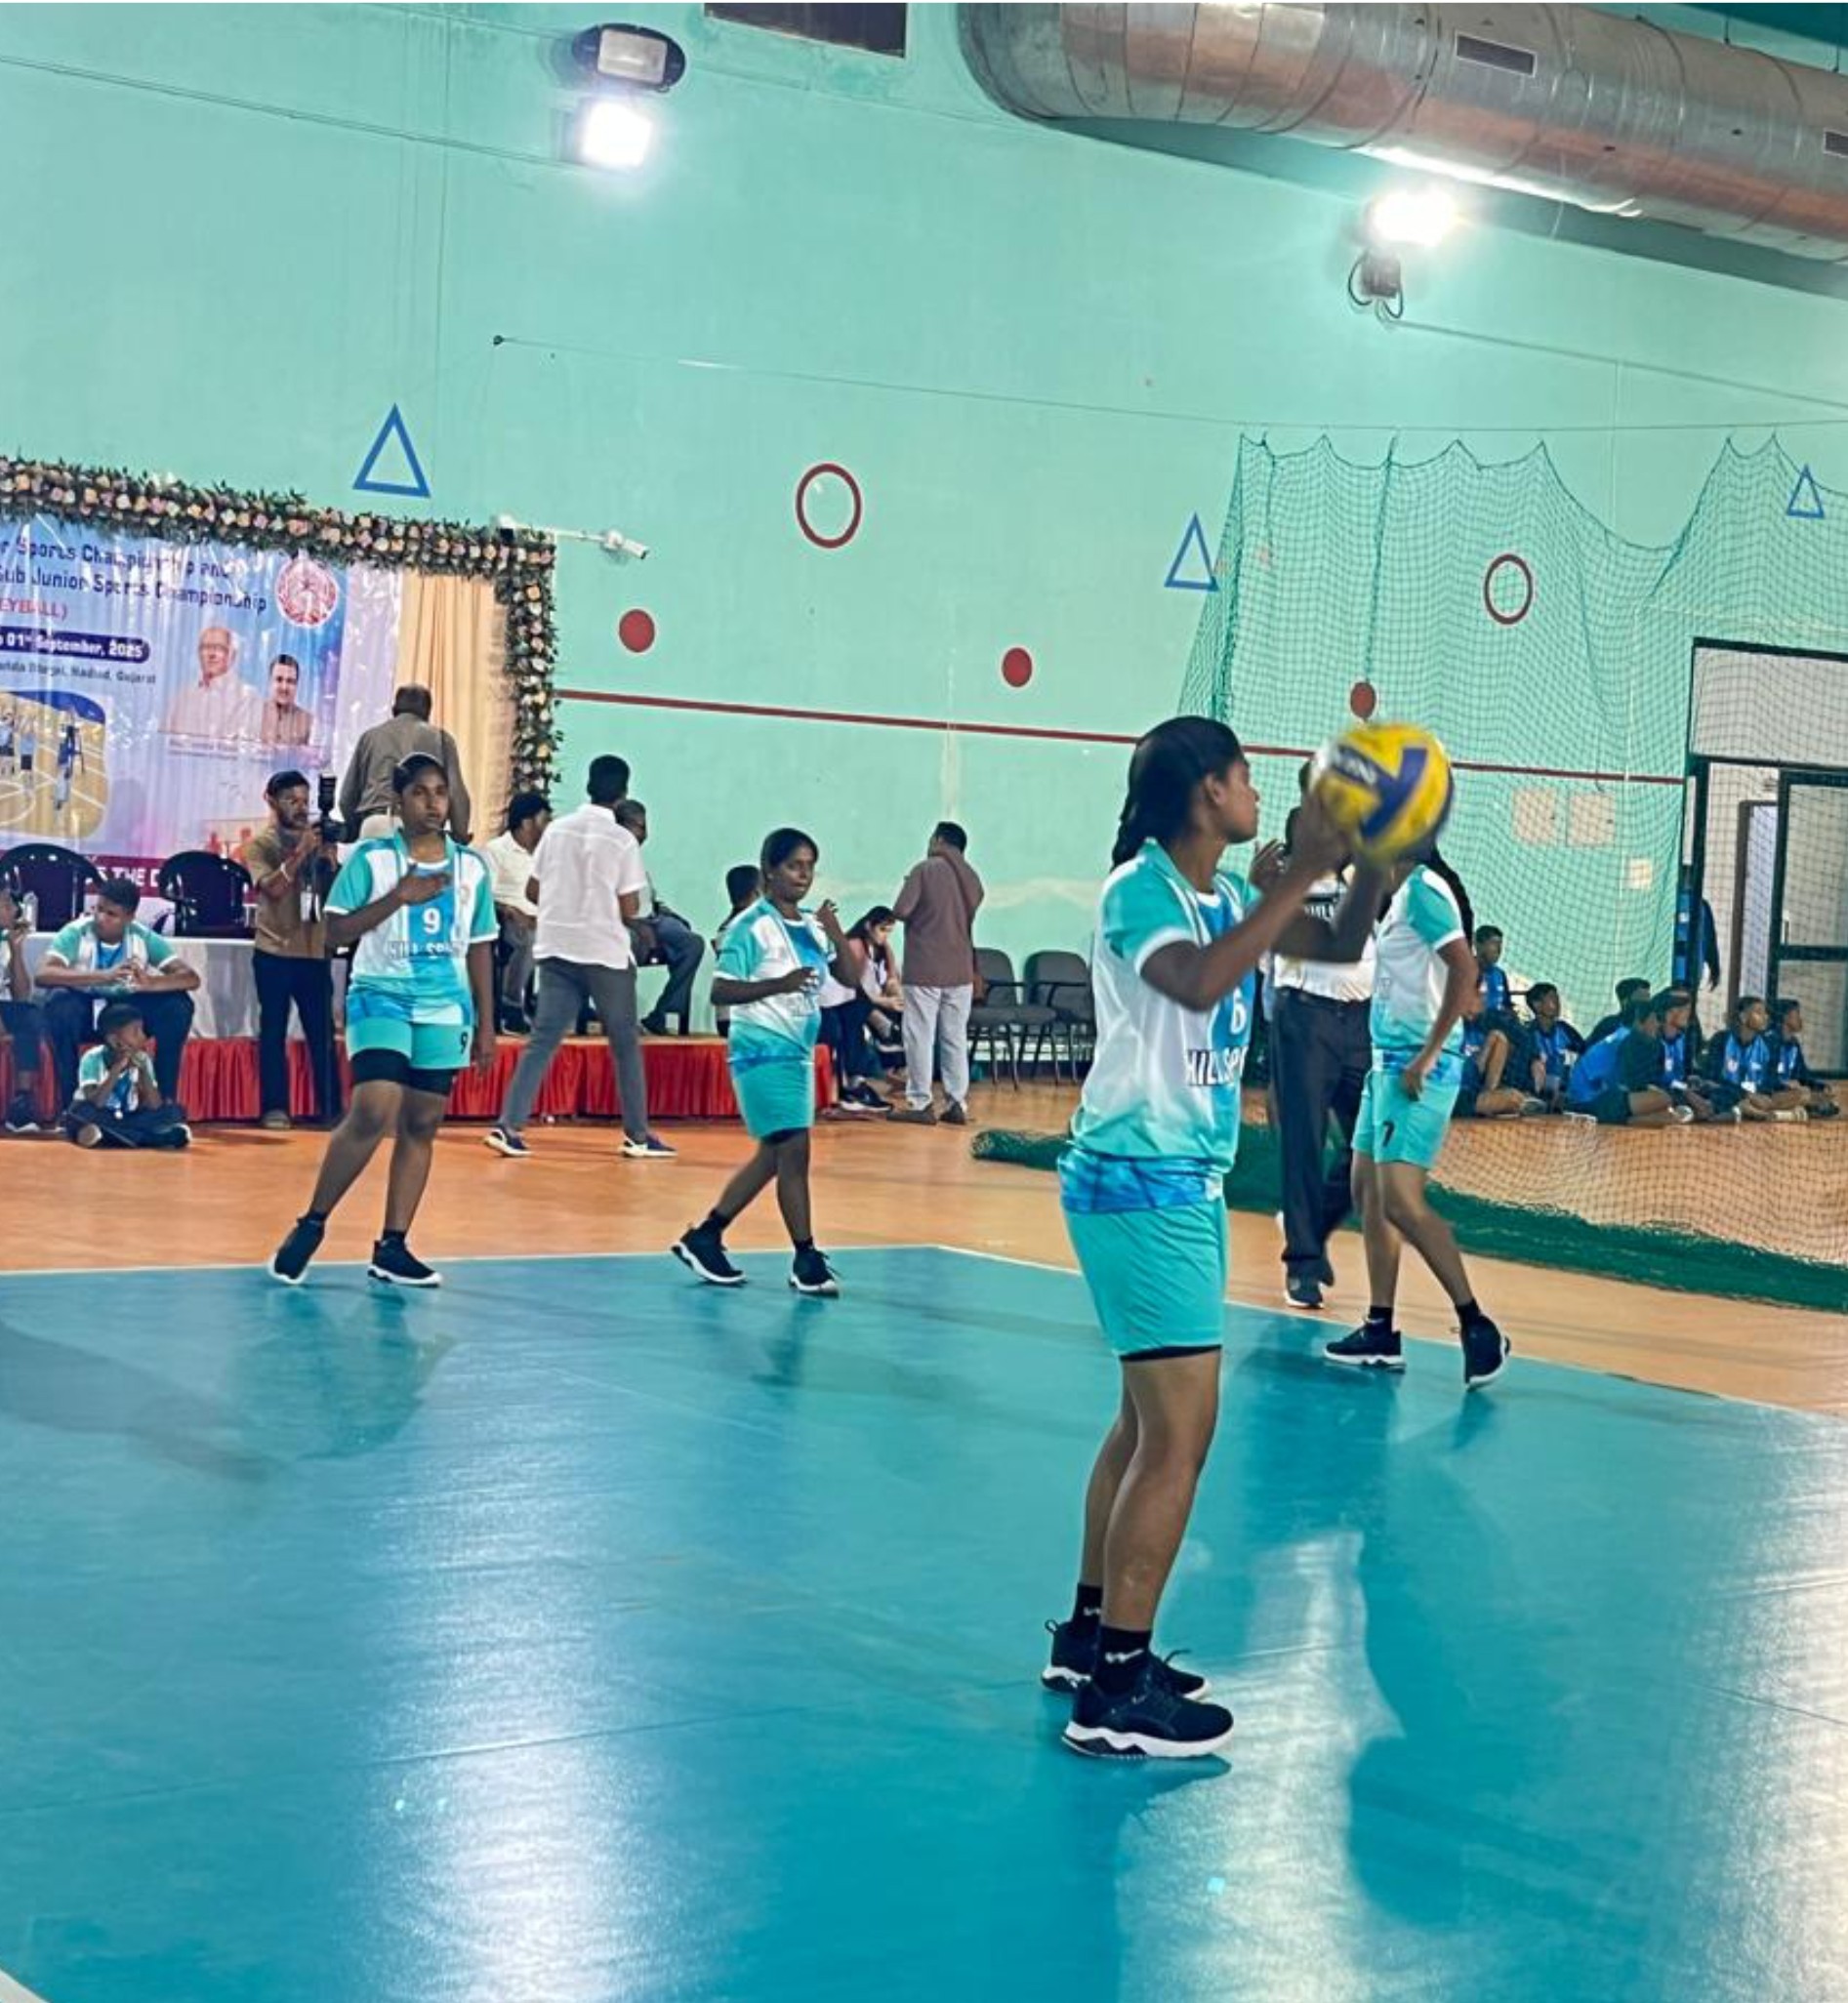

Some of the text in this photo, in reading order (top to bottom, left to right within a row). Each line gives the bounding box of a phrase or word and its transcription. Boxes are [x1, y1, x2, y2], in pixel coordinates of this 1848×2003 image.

[31, 566, 87, 591] Junior
[155, 581, 267, 615] Campionhip
[109, 639, 144, 658] 2025
[111, 866, 146, 886] THE
[423, 908, 441, 934] 9
[1382, 1120, 1395, 1149] 7
